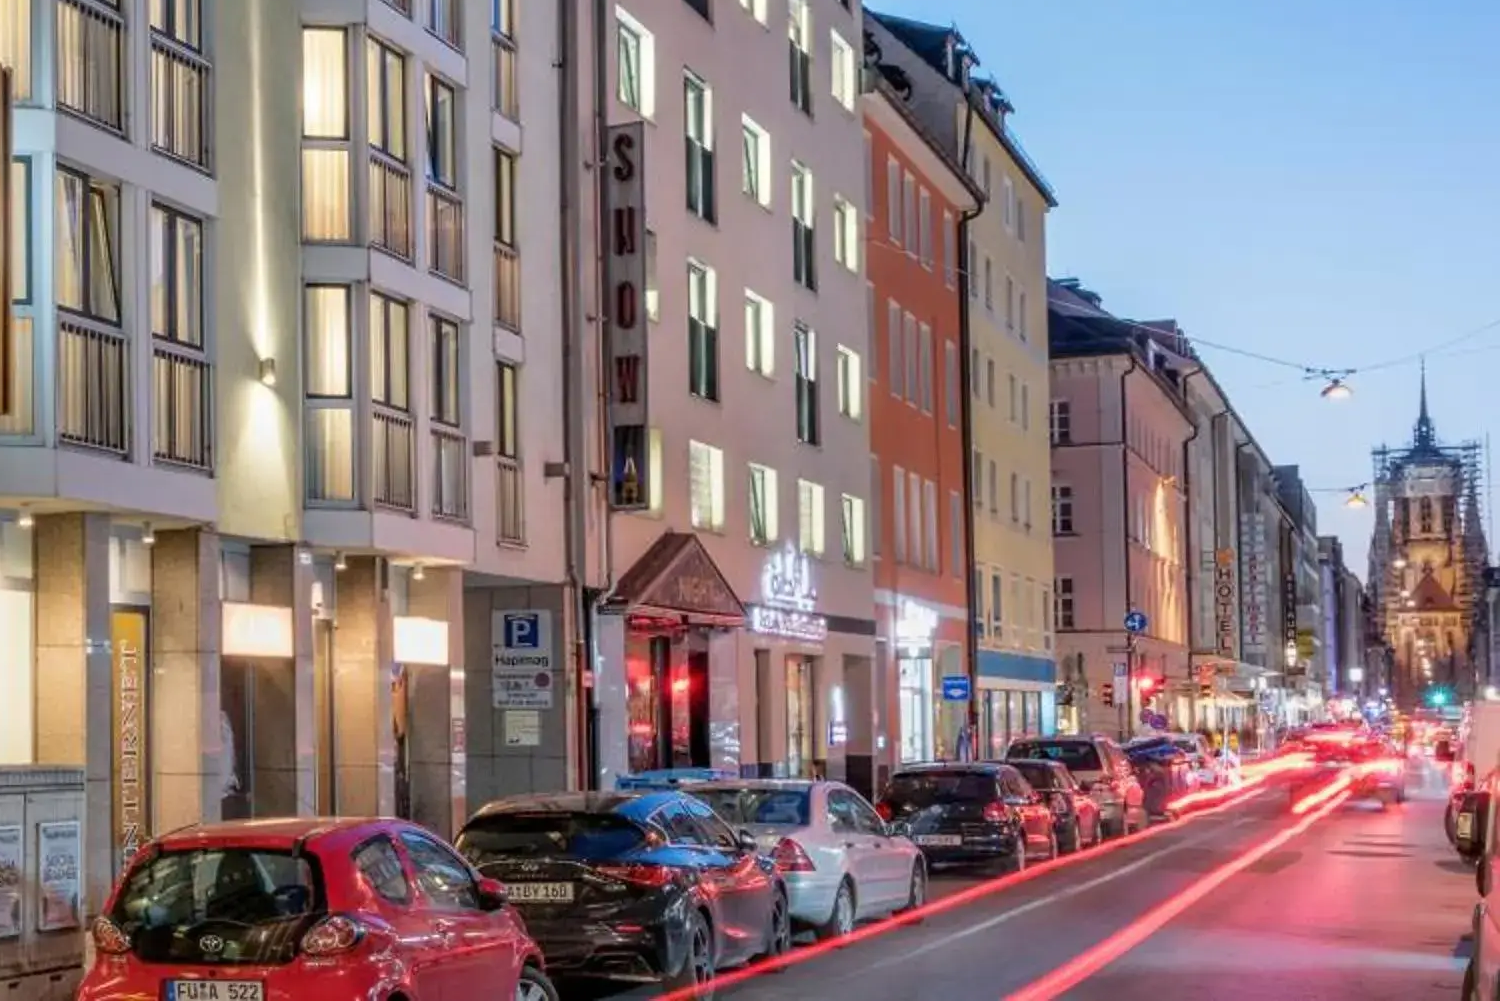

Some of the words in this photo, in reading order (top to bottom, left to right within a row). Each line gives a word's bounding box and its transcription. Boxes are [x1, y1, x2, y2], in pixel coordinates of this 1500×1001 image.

[613, 133, 640, 404] SHOW
[1218, 568, 1232, 651] HOTEL
[511, 619, 531, 649] P
[495, 655, 549, 668] Hapimag
[209, 982, 219, 1000] A
[227, 982, 260, 1000] 522
